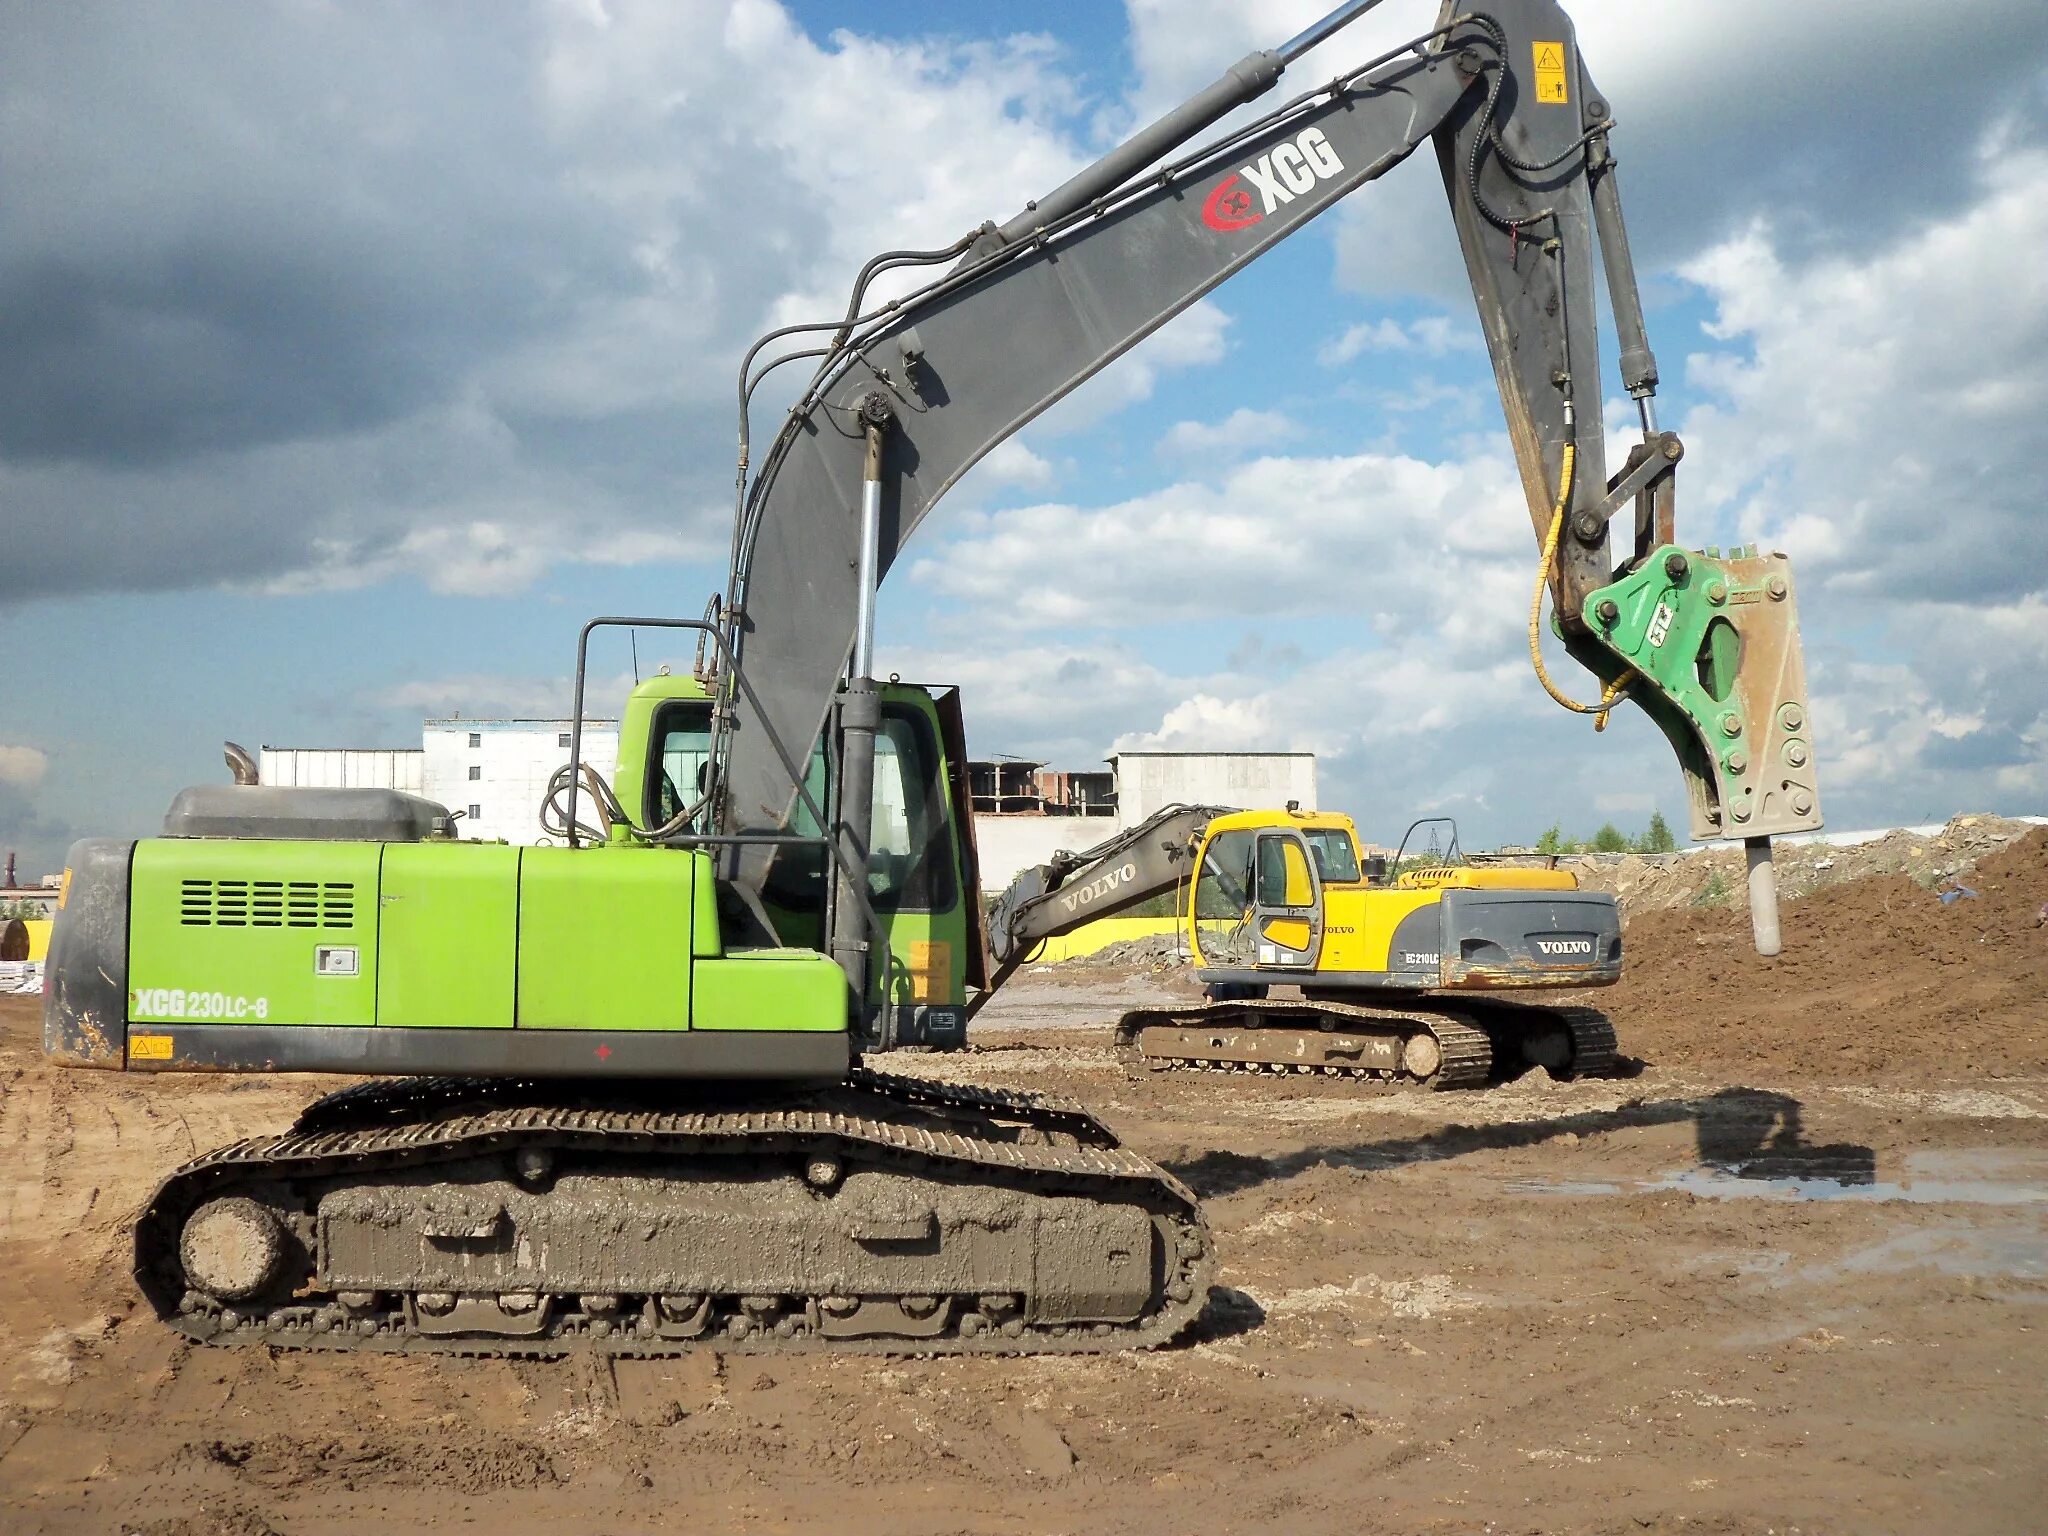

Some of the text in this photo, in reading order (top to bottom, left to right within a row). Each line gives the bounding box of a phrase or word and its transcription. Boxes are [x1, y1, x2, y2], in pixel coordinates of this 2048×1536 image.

[1239, 127, 1345, 215] XCG
[1061, 863, 1136, 912] VOLVO
[1536, 941, 1591, 955] VOLVO
[135, 989, 186, 1017] XCG
